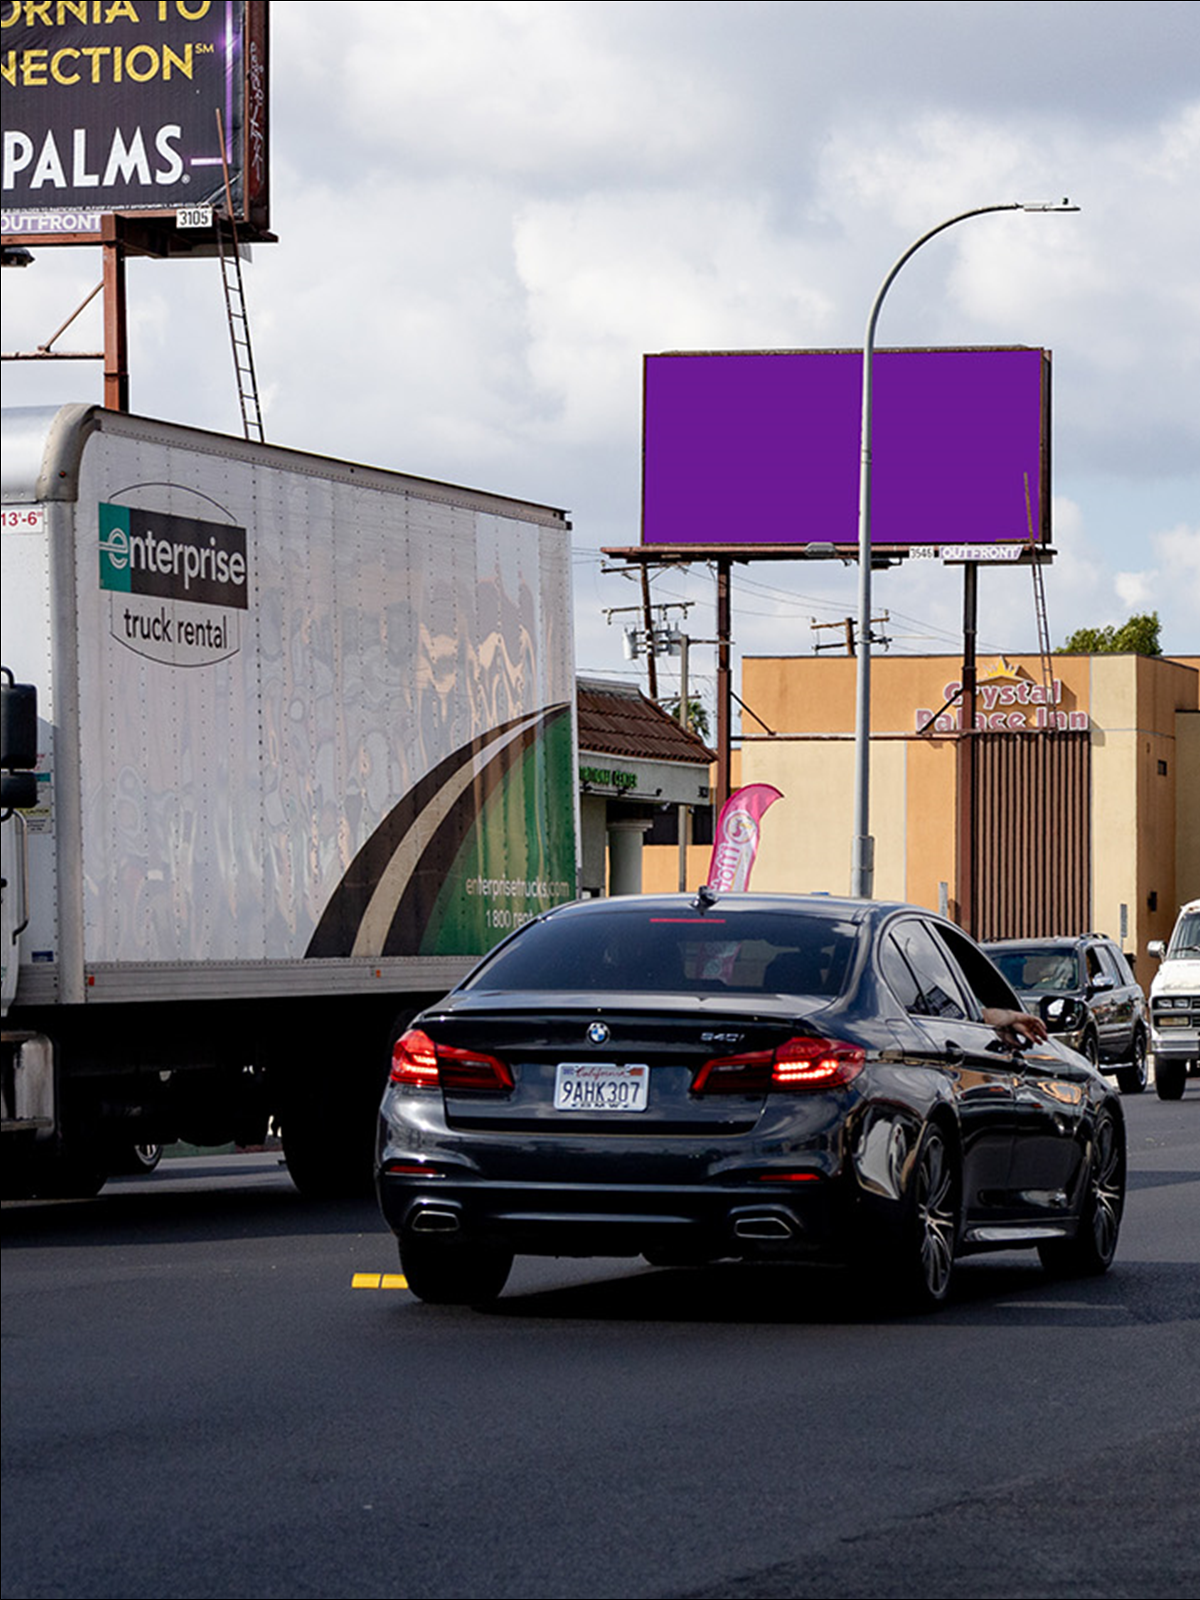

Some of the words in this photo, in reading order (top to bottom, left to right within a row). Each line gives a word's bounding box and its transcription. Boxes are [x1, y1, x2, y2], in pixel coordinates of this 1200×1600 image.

[1, 43, 193, 87] NECTION
[1, 213, 101, 231] OUTFRONT
[180, 210, 209, 225] 3105
[103, 527, 246, 590] enterprise
[942, 546, 1019, 559] OUTFRONT
[123, 606, 173, 643] truck
[177, 615, 228, 649] rental
[944, 679, 1061, 710] Cystal
[1036, 706, 1089, 731] Inn
[465, 872, 570, 902] enterprisetrucks.com
[561, 1080, 640, 1103] 9AHK307
